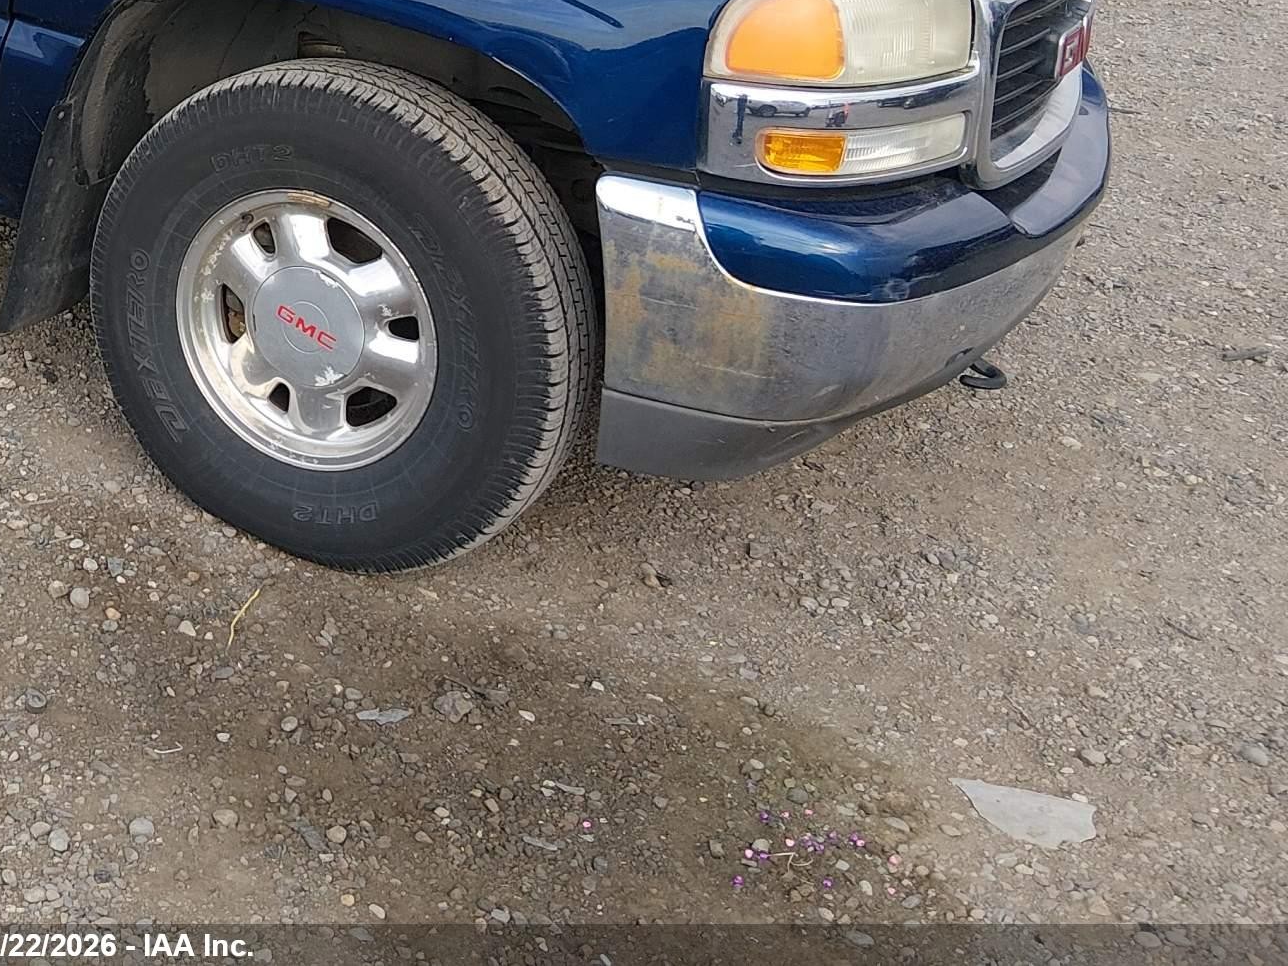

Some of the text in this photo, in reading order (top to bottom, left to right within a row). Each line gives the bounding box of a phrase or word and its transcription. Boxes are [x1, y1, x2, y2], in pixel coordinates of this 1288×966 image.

[126, 248, 191, 444] DEXTERO
[276, 305, 337, 350] GMC
[292, 500, 378, 526] DHT2
